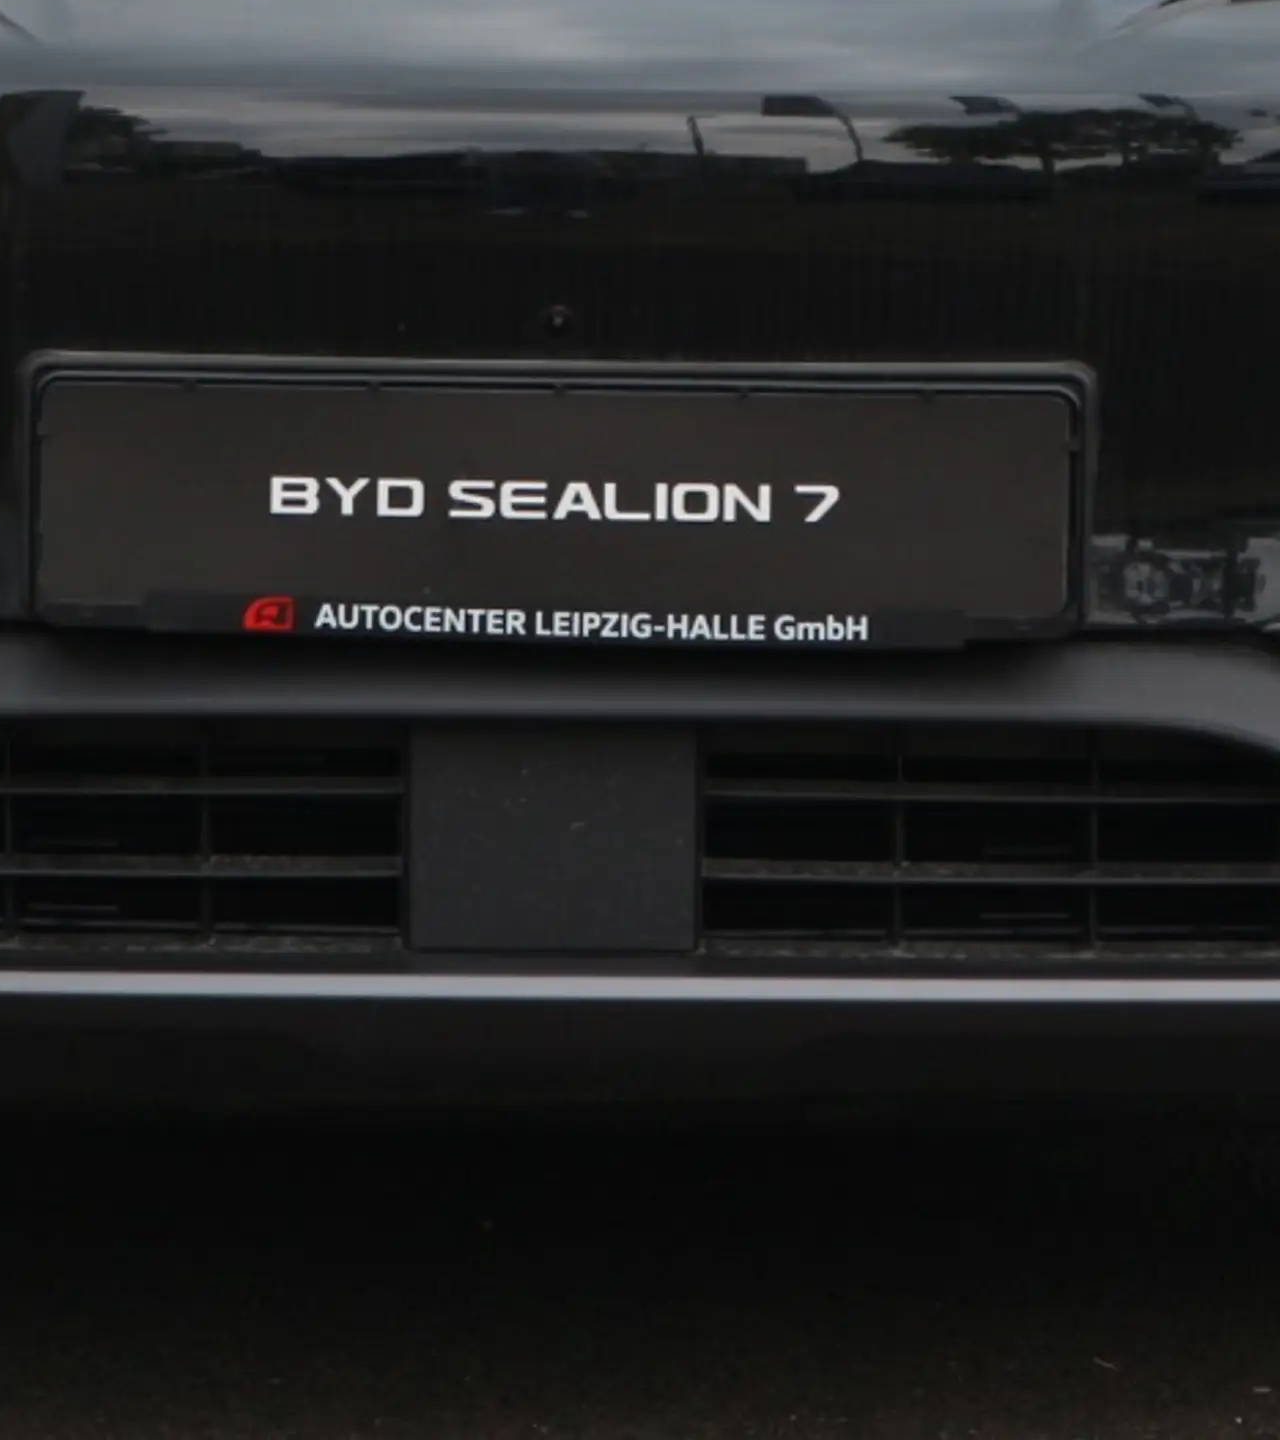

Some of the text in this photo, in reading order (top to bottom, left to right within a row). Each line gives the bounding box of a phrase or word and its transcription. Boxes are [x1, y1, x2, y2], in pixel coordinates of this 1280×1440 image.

[270, 476, 840, 523] BYD SEALION 7
[314, 603, 868, 641] AUTOCENTER LEIPZIG-HALLE GmbH
